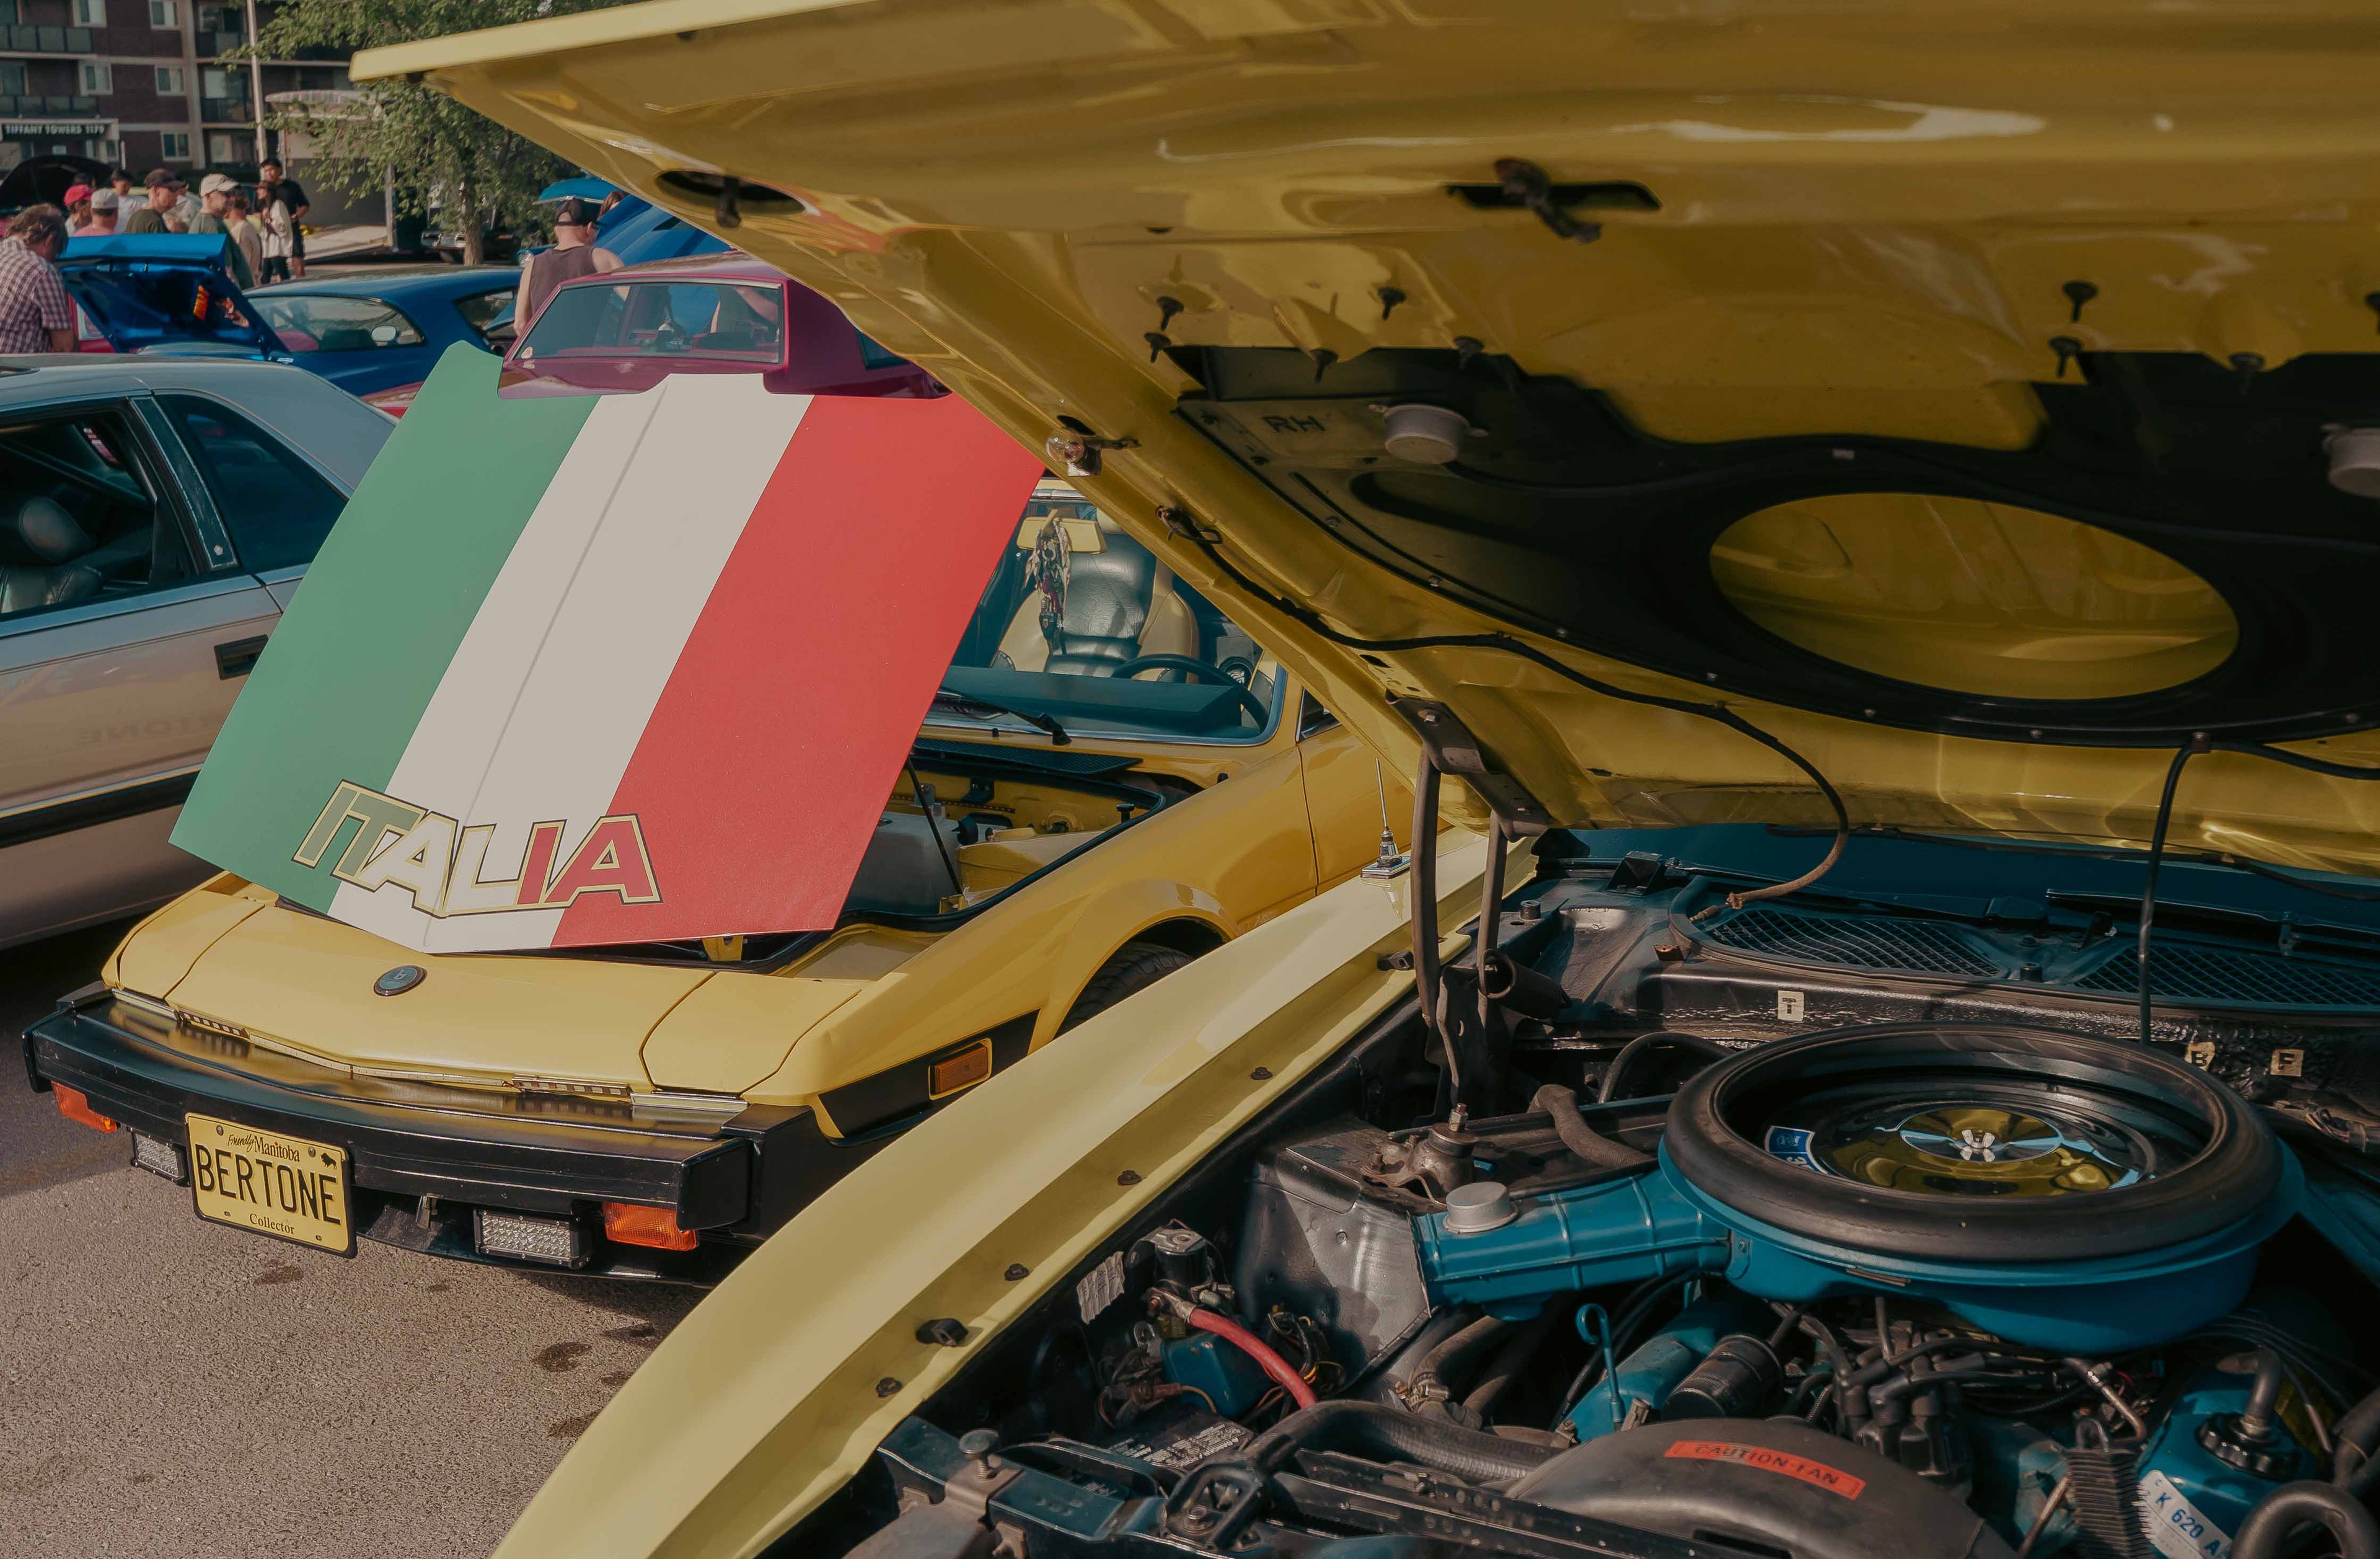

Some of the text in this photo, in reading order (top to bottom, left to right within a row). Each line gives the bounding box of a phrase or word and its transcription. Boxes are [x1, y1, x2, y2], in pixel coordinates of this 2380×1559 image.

[5, 125, 43, 135] TIFFANY
[1262, 415, 1326, 433] RH
[291, 779, 664, 919] ITALIA
[227, 1134, 300, 1163] Friendly Manitoba
[195, 1144, 341, 1225] BERTONE
[249, 1213, 295, 1235] Collector
[1695, 1446, 1840, 1485] CAUTION FAN
[2156, 1491, 2172, 1509] K
[2171, 1508, 2205, 1539] 620
[2204, 1539, 2221, 1557] A
